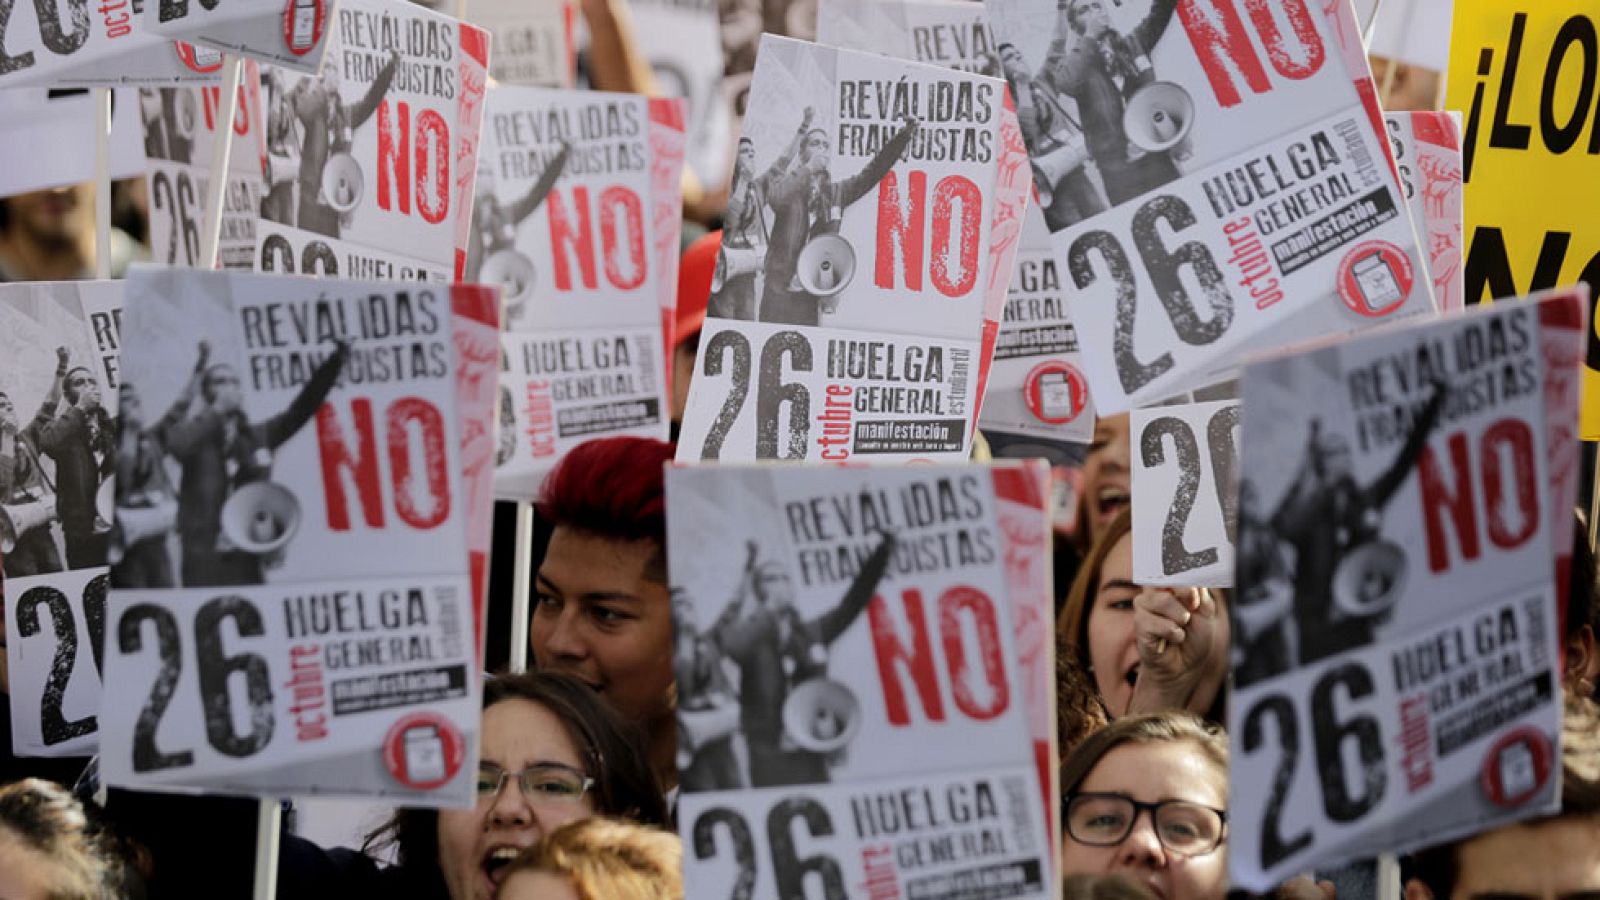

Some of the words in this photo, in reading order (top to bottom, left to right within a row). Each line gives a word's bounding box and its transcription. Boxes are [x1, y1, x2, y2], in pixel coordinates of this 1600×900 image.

[339, 8, 453, 62] REVÁLIDAS
[1176, 0, 1326, 108] NO
[839, 75, 993, 125] REVÁLIDAS
[1463, 12, 1600, 184] ¡LO
[376, 98, 450, 225] NO
[1201, 130, 1342, 219] HUELGA
[1254, 171, 1360, 236] GENERAL
[545, 185, 647, 291] NO
[874, 169, 983, 298] NO
[1222, 215, 1284, 311] octubre
[1003, 297, 1068, 322] NERAL
[1067, 194, 1236, 395] 26
[700, 329, 814, 461] 26
[826, 338, 944, 384] HUELGA
[854, 385, 945, 416] GENERAL
[315, 395, 453, 533] NO
[857, 422, 950, 441] manifestación
[1417, 417, 1541, 575] NO
[284, 587, 428, 640] HUELGA
[868, 585, 1011, 728] NO
[117, 594, 276, 775] 26
[1242, 659, 1388, 873] 26
